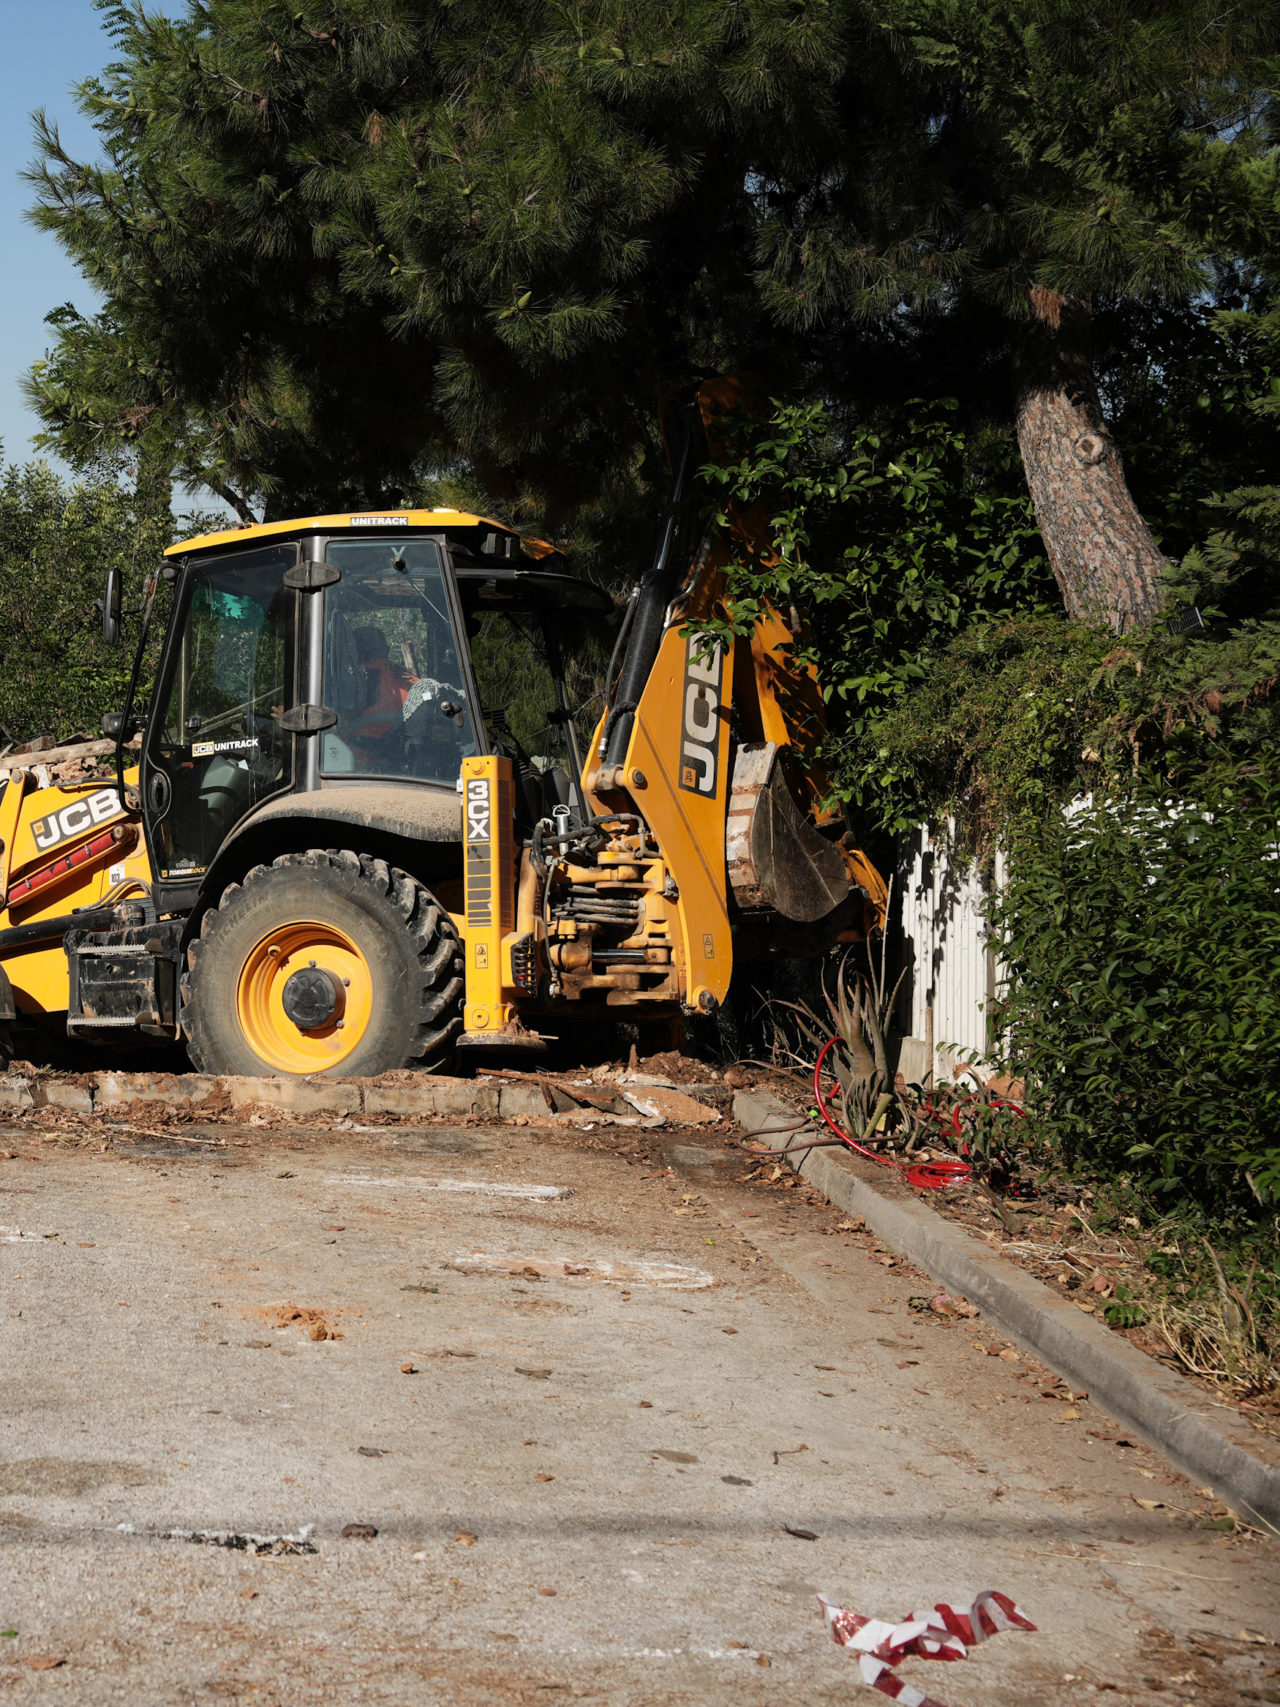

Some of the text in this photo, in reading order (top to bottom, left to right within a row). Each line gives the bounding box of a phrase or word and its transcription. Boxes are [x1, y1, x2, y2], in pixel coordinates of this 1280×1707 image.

[351, 517, 407, 526] UNITRACK
[194, 738, 259, 754] JCB UNITRACK
[37, 788, 122, 848] JCB
[468, 780, 490, 838] 3CX
